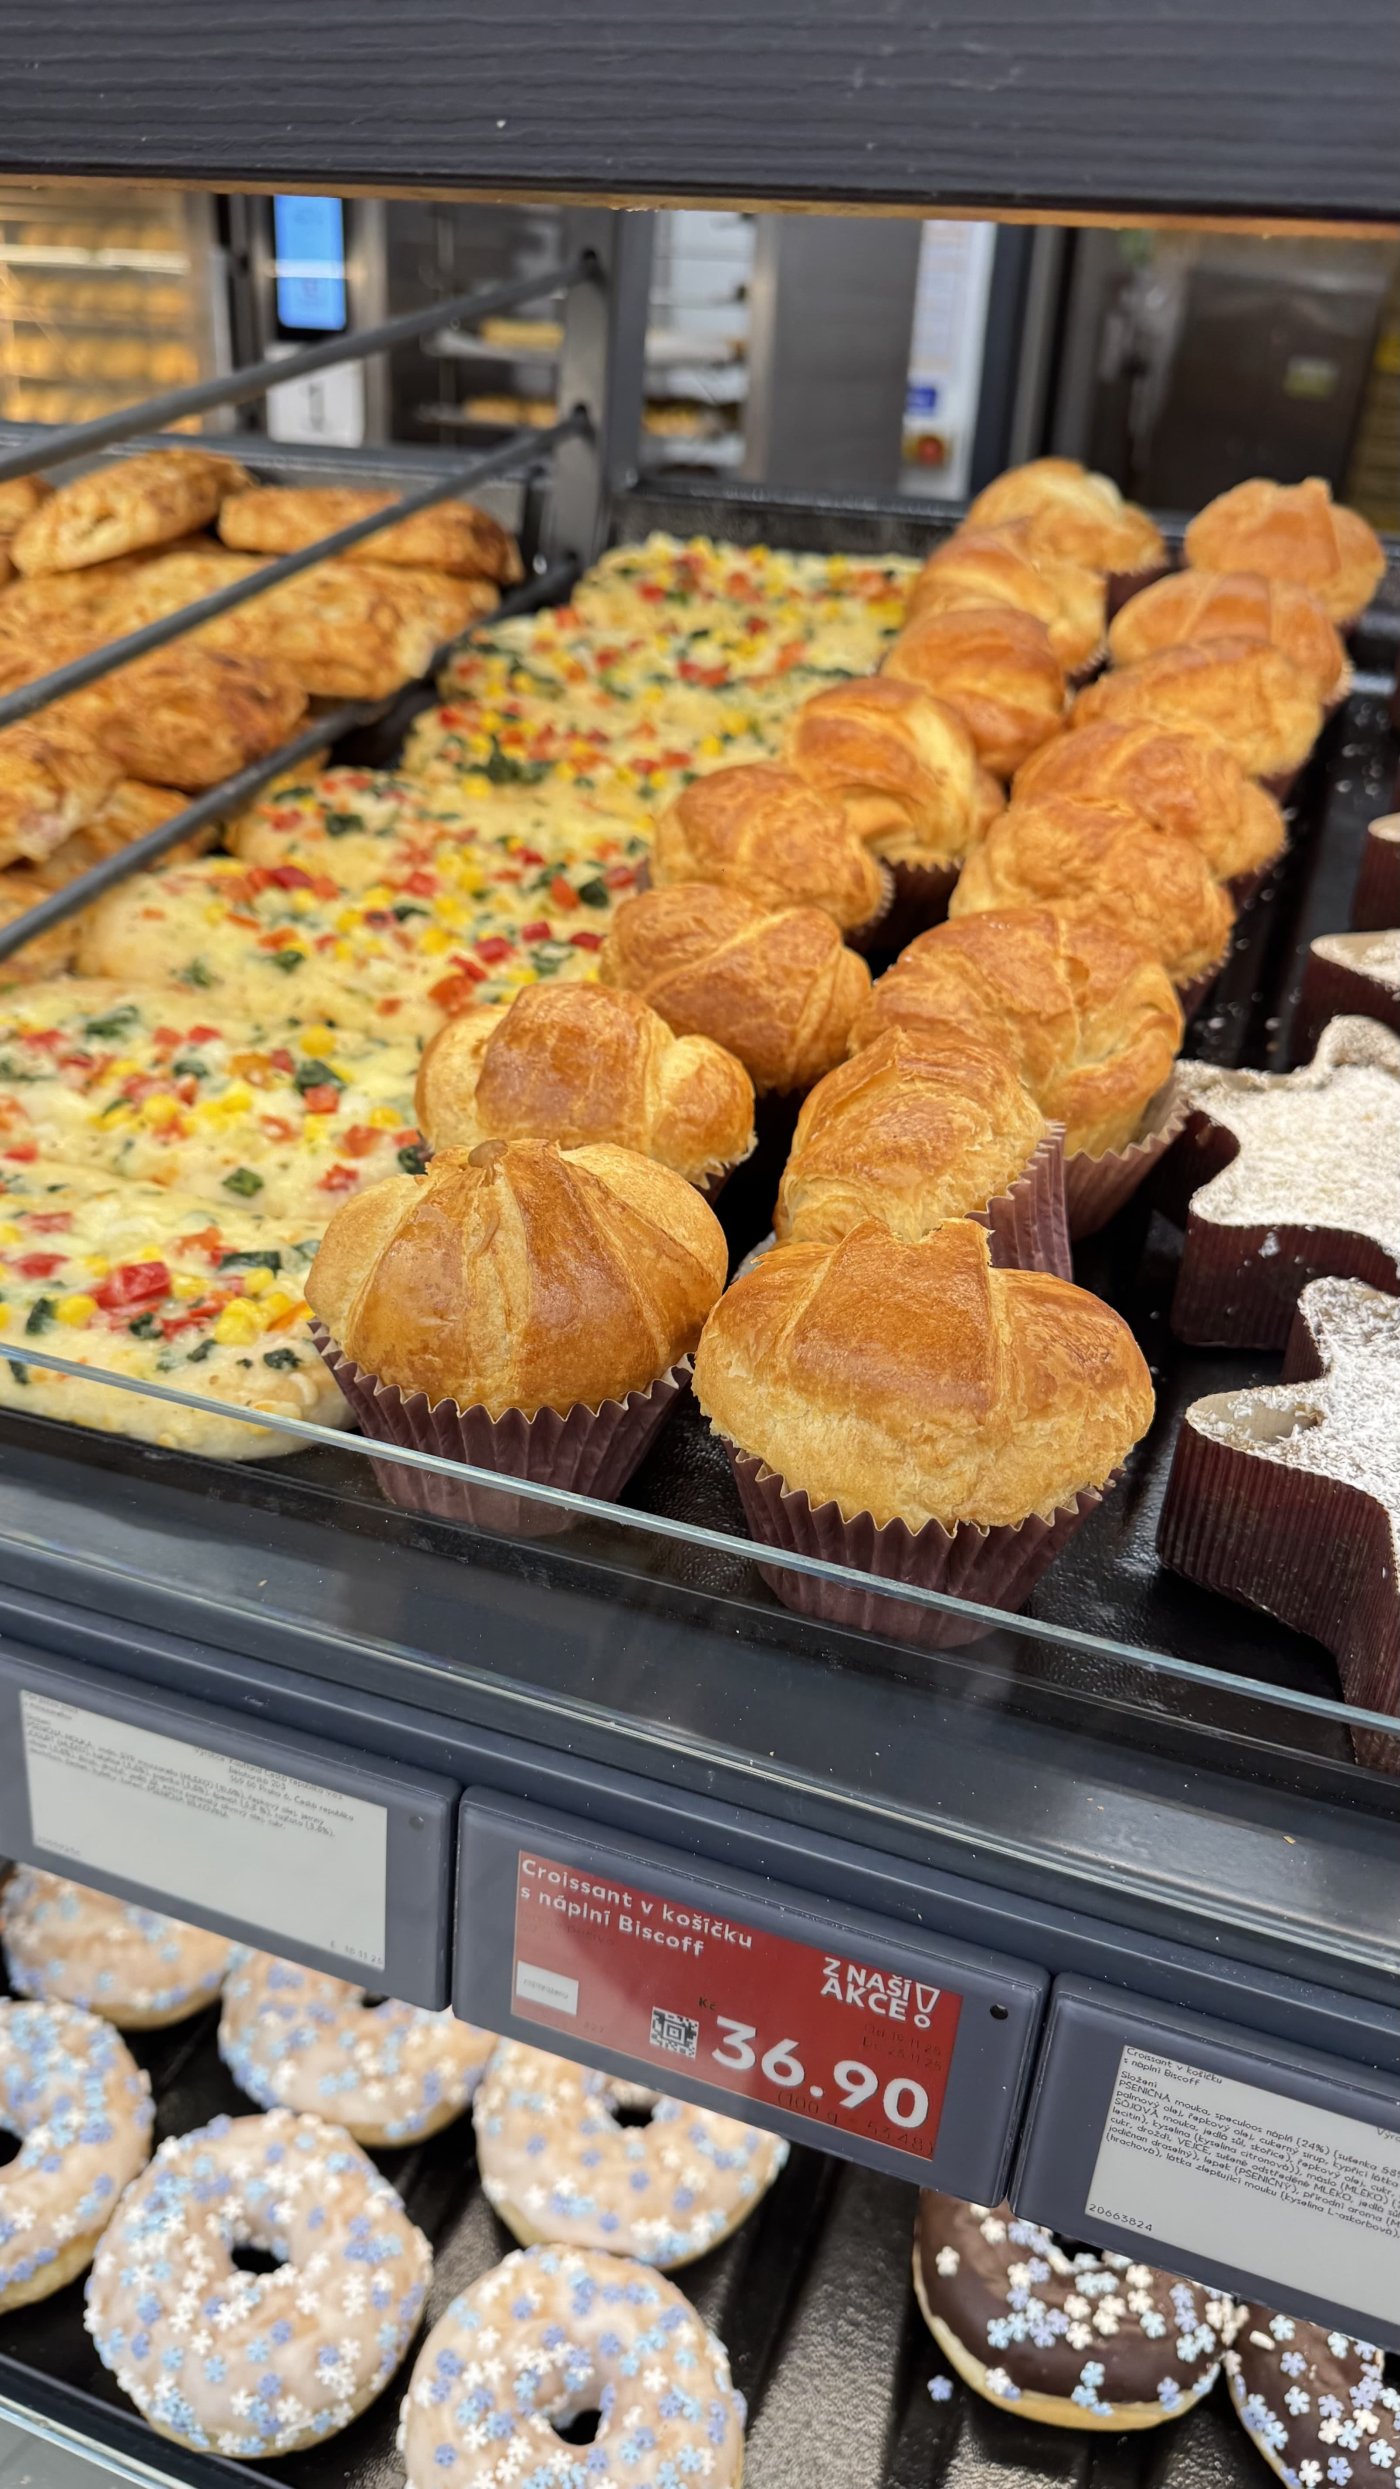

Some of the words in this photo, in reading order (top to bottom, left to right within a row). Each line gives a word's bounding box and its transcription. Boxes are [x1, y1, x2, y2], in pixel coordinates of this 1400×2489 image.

[522, 1858, 632, 1908] Croissant
[640, 1900, 653, 1914] v
[662, 1904, 753, 1948] košíčku
[520, 1886, 530, 1899] s
[538, 1888, 611, 1927] náplní
[618, 1915, 705, 1957] Biscoff
[822, 1957, 841, 1976] Z
[846, 1962, 912, 1999] NAŠÍ
[820, 1975, 908, 2020] AKCE
[1126, 2047, 1172, 2067] Croissant
[711, 2018, 931, 2129] 36.90
[1120, 2070, 1157, 2087] Složení
[1131, 2059, 1161, 2074] náplní
[1163, 2068, 1200, 2085] Biscoff
[1116, 2089, 1159, 2108] palmový
[1174, 2098, 1211, 2116] mouka,
[1214, 2111, 1262, 2132] speculoos
[1151, 2120, 1191, 2139] kyselina
[1243, 2179, 1277, 2196] mouku
[1088, 2203, 1153, 2231] 20663824
[1347, 2205, 1382, 2223] aroma
